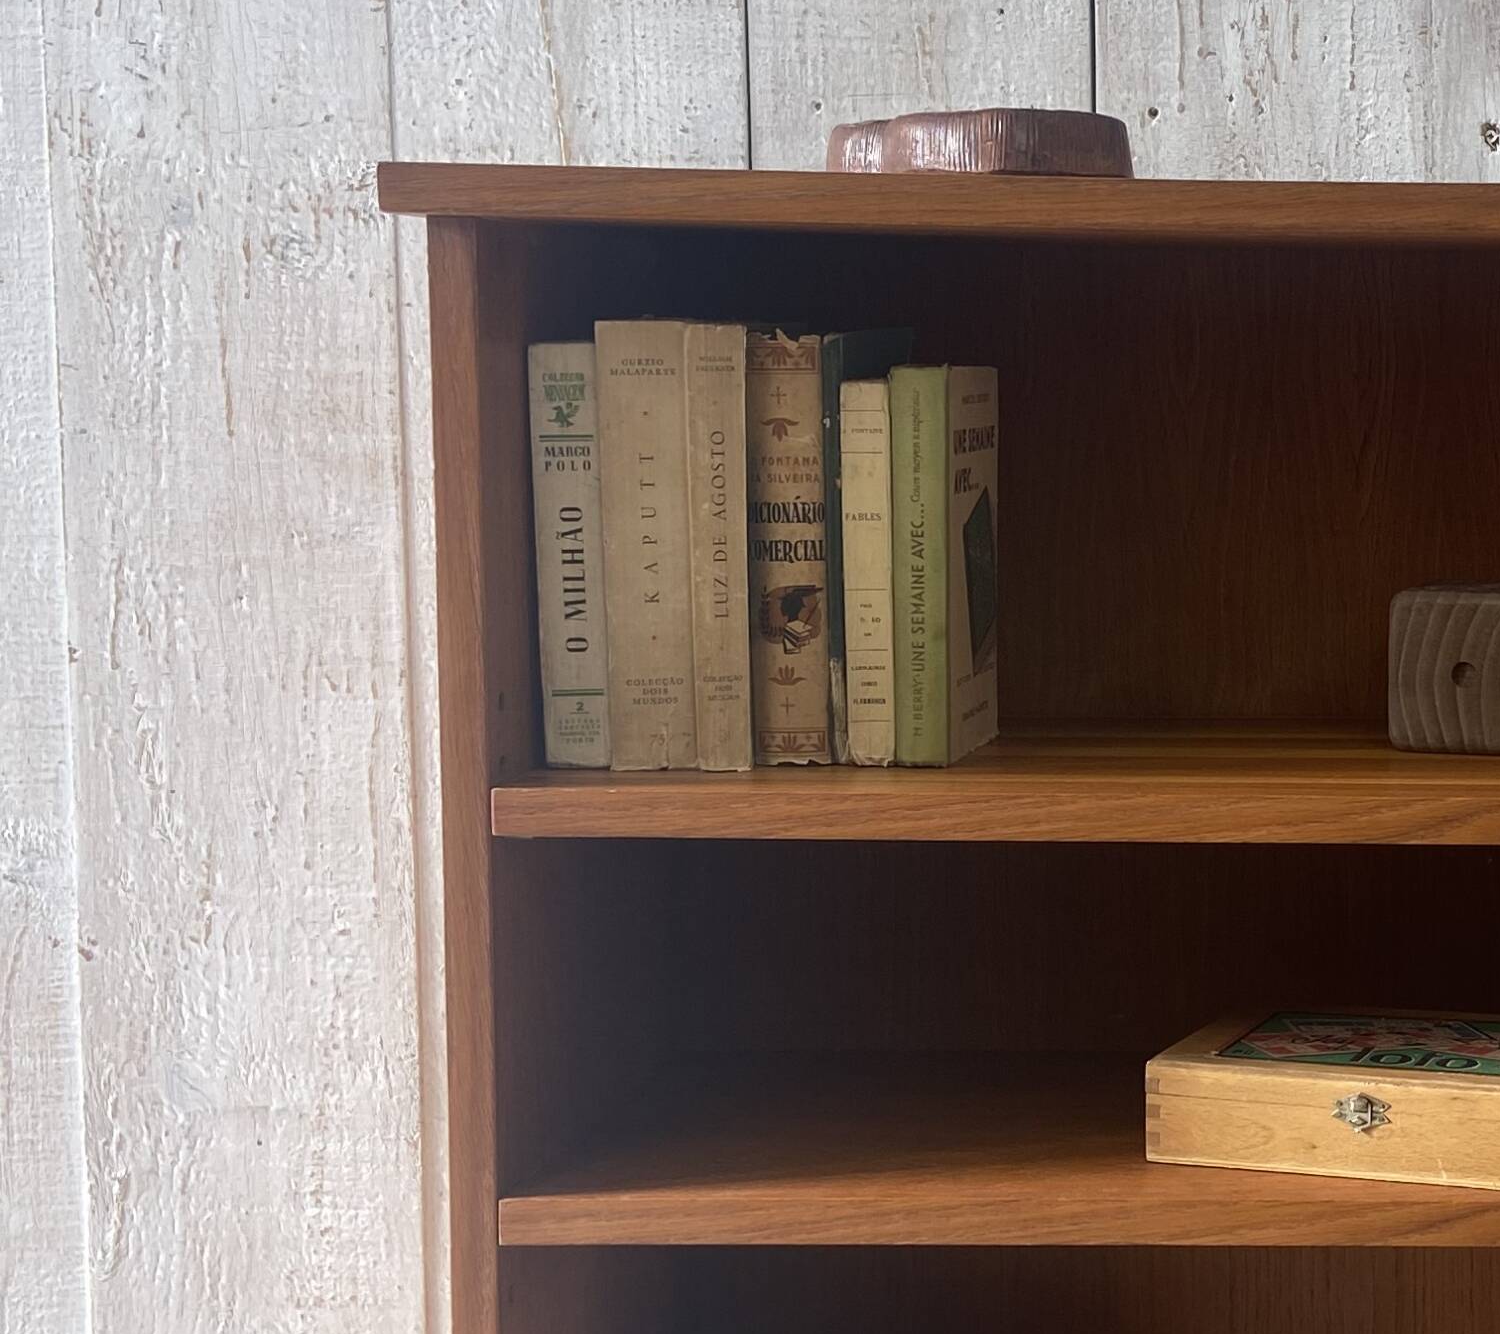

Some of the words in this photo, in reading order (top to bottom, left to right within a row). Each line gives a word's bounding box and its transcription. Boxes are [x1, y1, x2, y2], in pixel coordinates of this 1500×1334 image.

[609, 367, 677, 376] MALAPARTE
[544, 446, 591, 458] MARCO
[544, 460, 592, 472] POLO
[761, 456, 820, 467] FONTANA
[710, 430, 728, 521] AGOSTO
[767, 473, 820, 483] SILVEIRA
[845, 512, 882, 521] FABLES
[639, 453, 660, 604] KAPUTT
[713, 535, 728, 563] DE
[555, 506, 588, 623] MILHÃO
[713, 576, 729, 619] LUZ
[910, 563, 926, 635] SEMAINE
[565, 636, 589, 653] O
[911, 640, 926, 672] UNE
[625, 676, 685, 687] COLECÇÃO
[642, 687, 669, 696] DOIS
[575, 701, 585, 712] 2
[632, 696, 679, 705] MUNDOS
